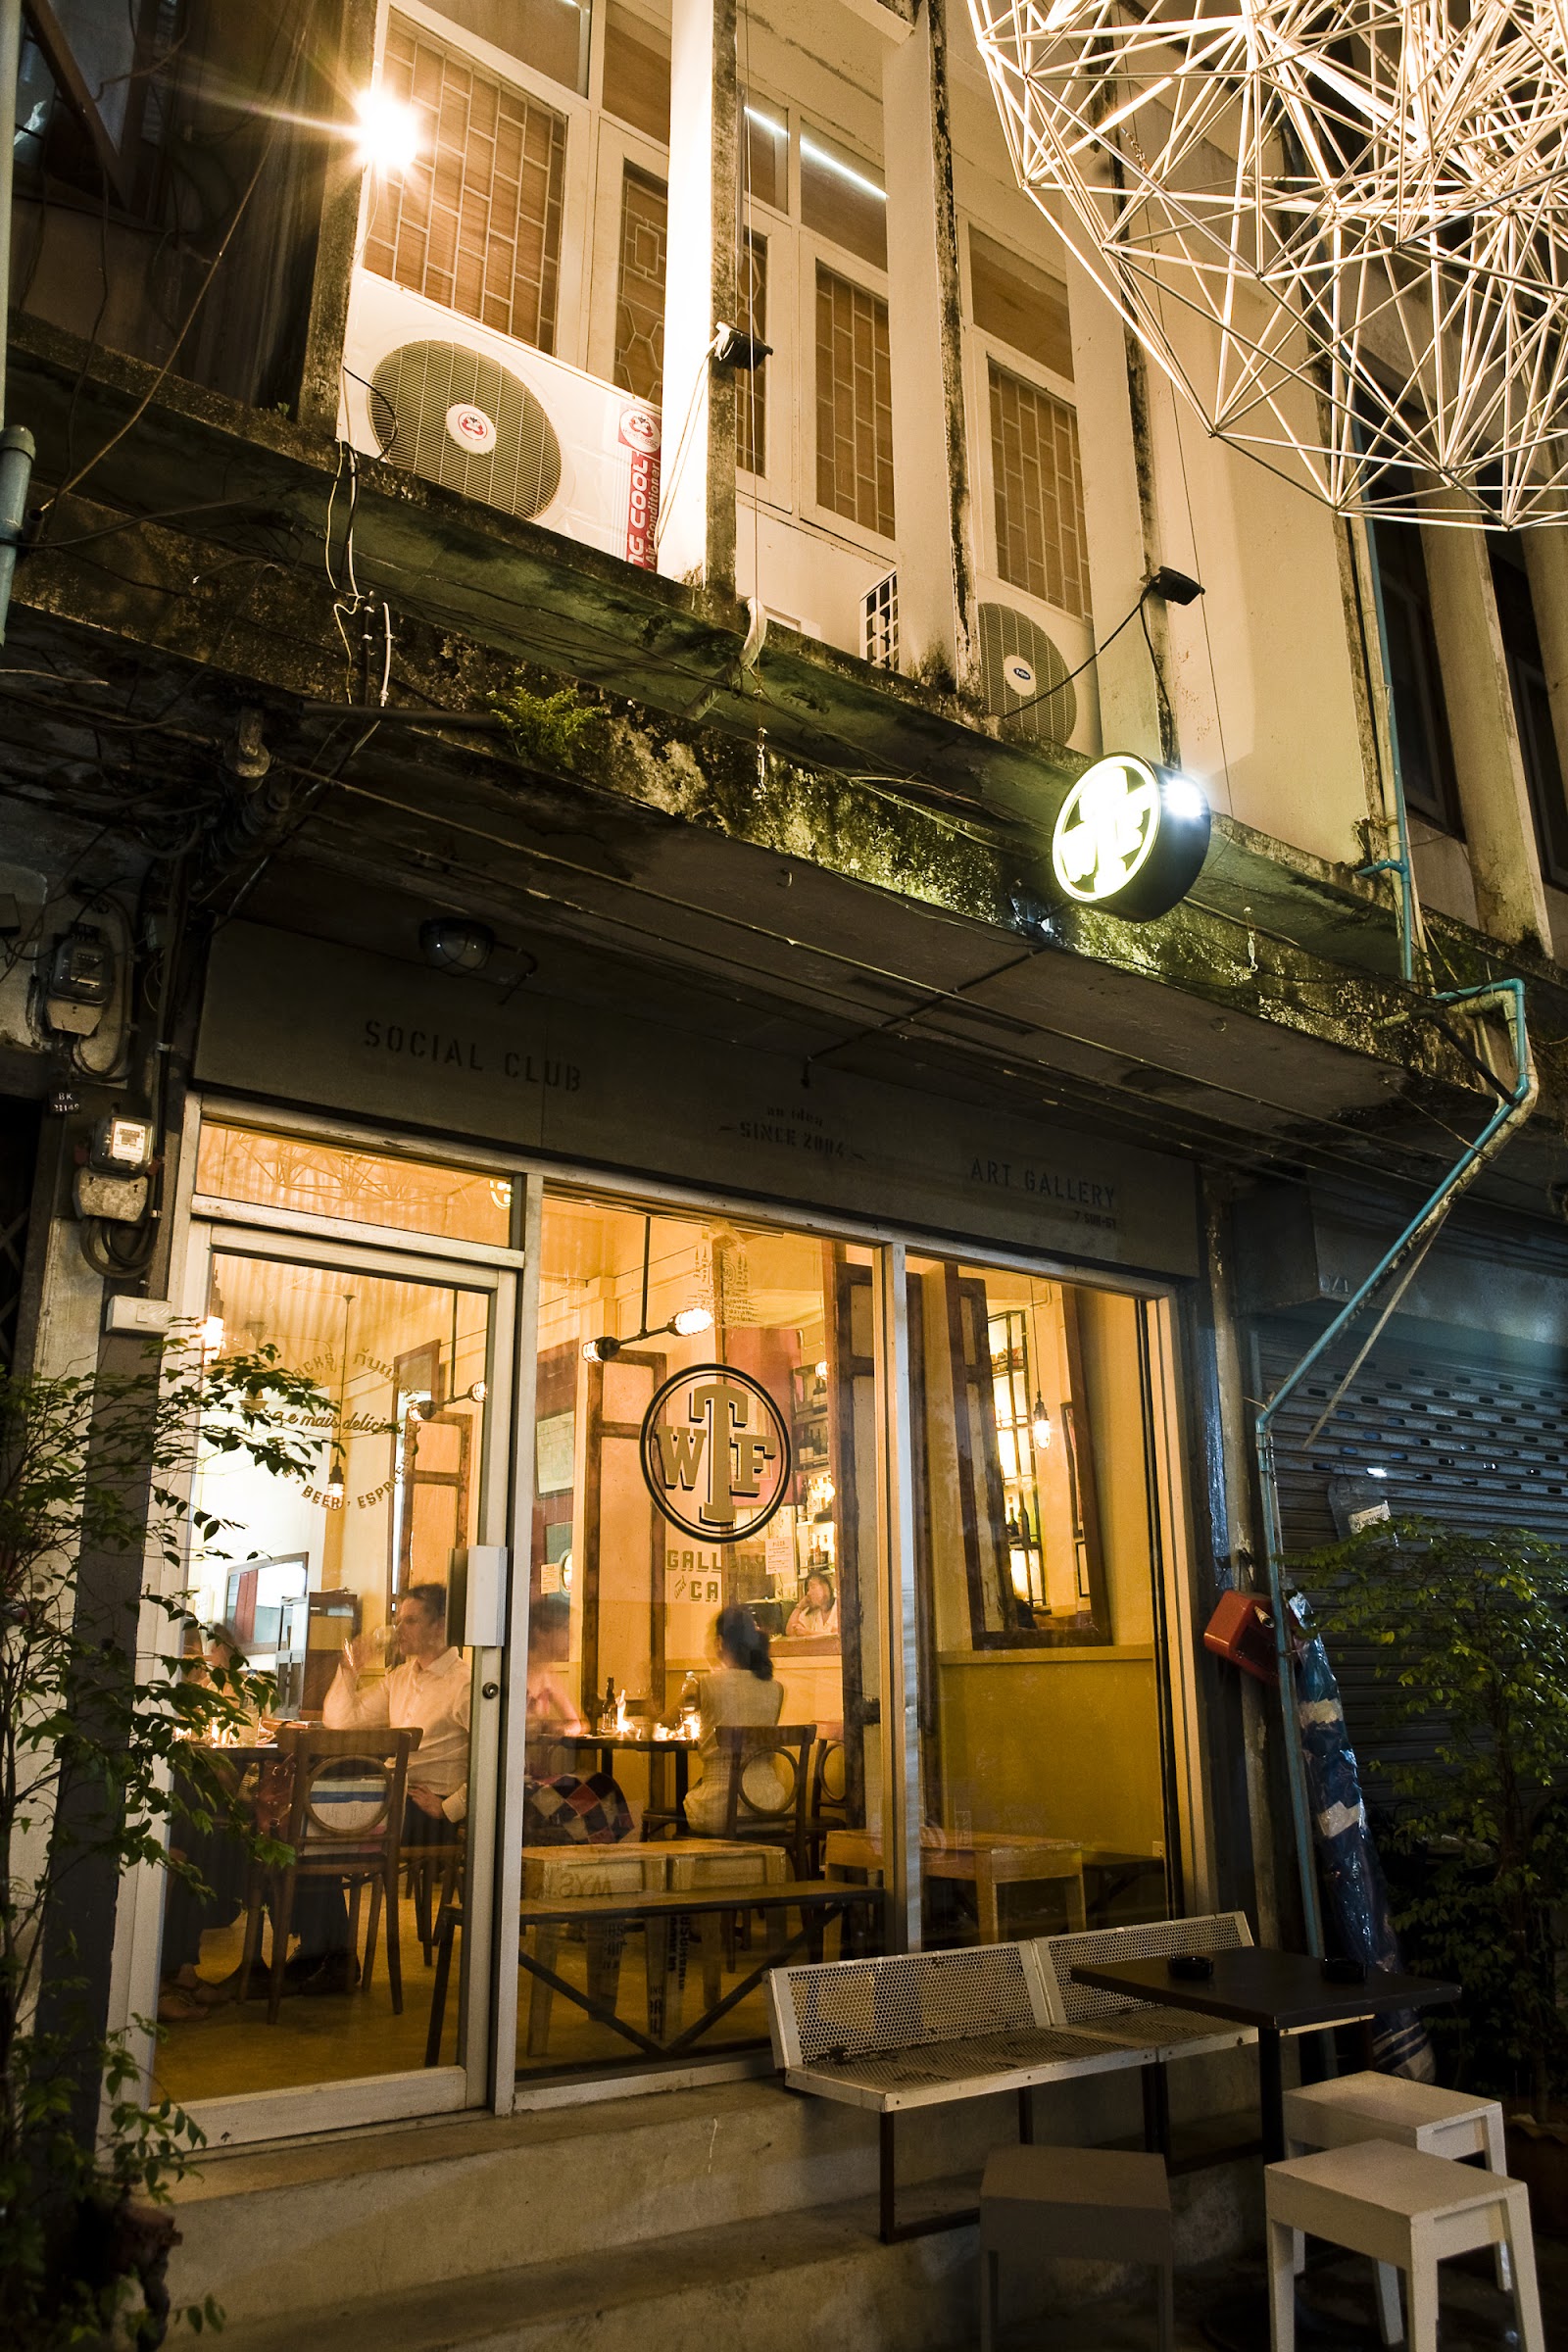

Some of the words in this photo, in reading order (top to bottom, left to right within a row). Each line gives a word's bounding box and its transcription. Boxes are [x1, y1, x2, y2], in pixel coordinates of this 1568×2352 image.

[630, 459, 649, 529] COOL
[646, 463, 661, 541] Conditioner
[365, 1020, 483, 1071] SOCIAL
[505, 1052, 581, 1092] CLUB
[740, 1121, 797, 1147] SINCE
[971, 1157, 1011, 1187] ART
[1025, 1168, 1114, 1208] GALLERY
[655, 1384, 776, 1527] WTF
